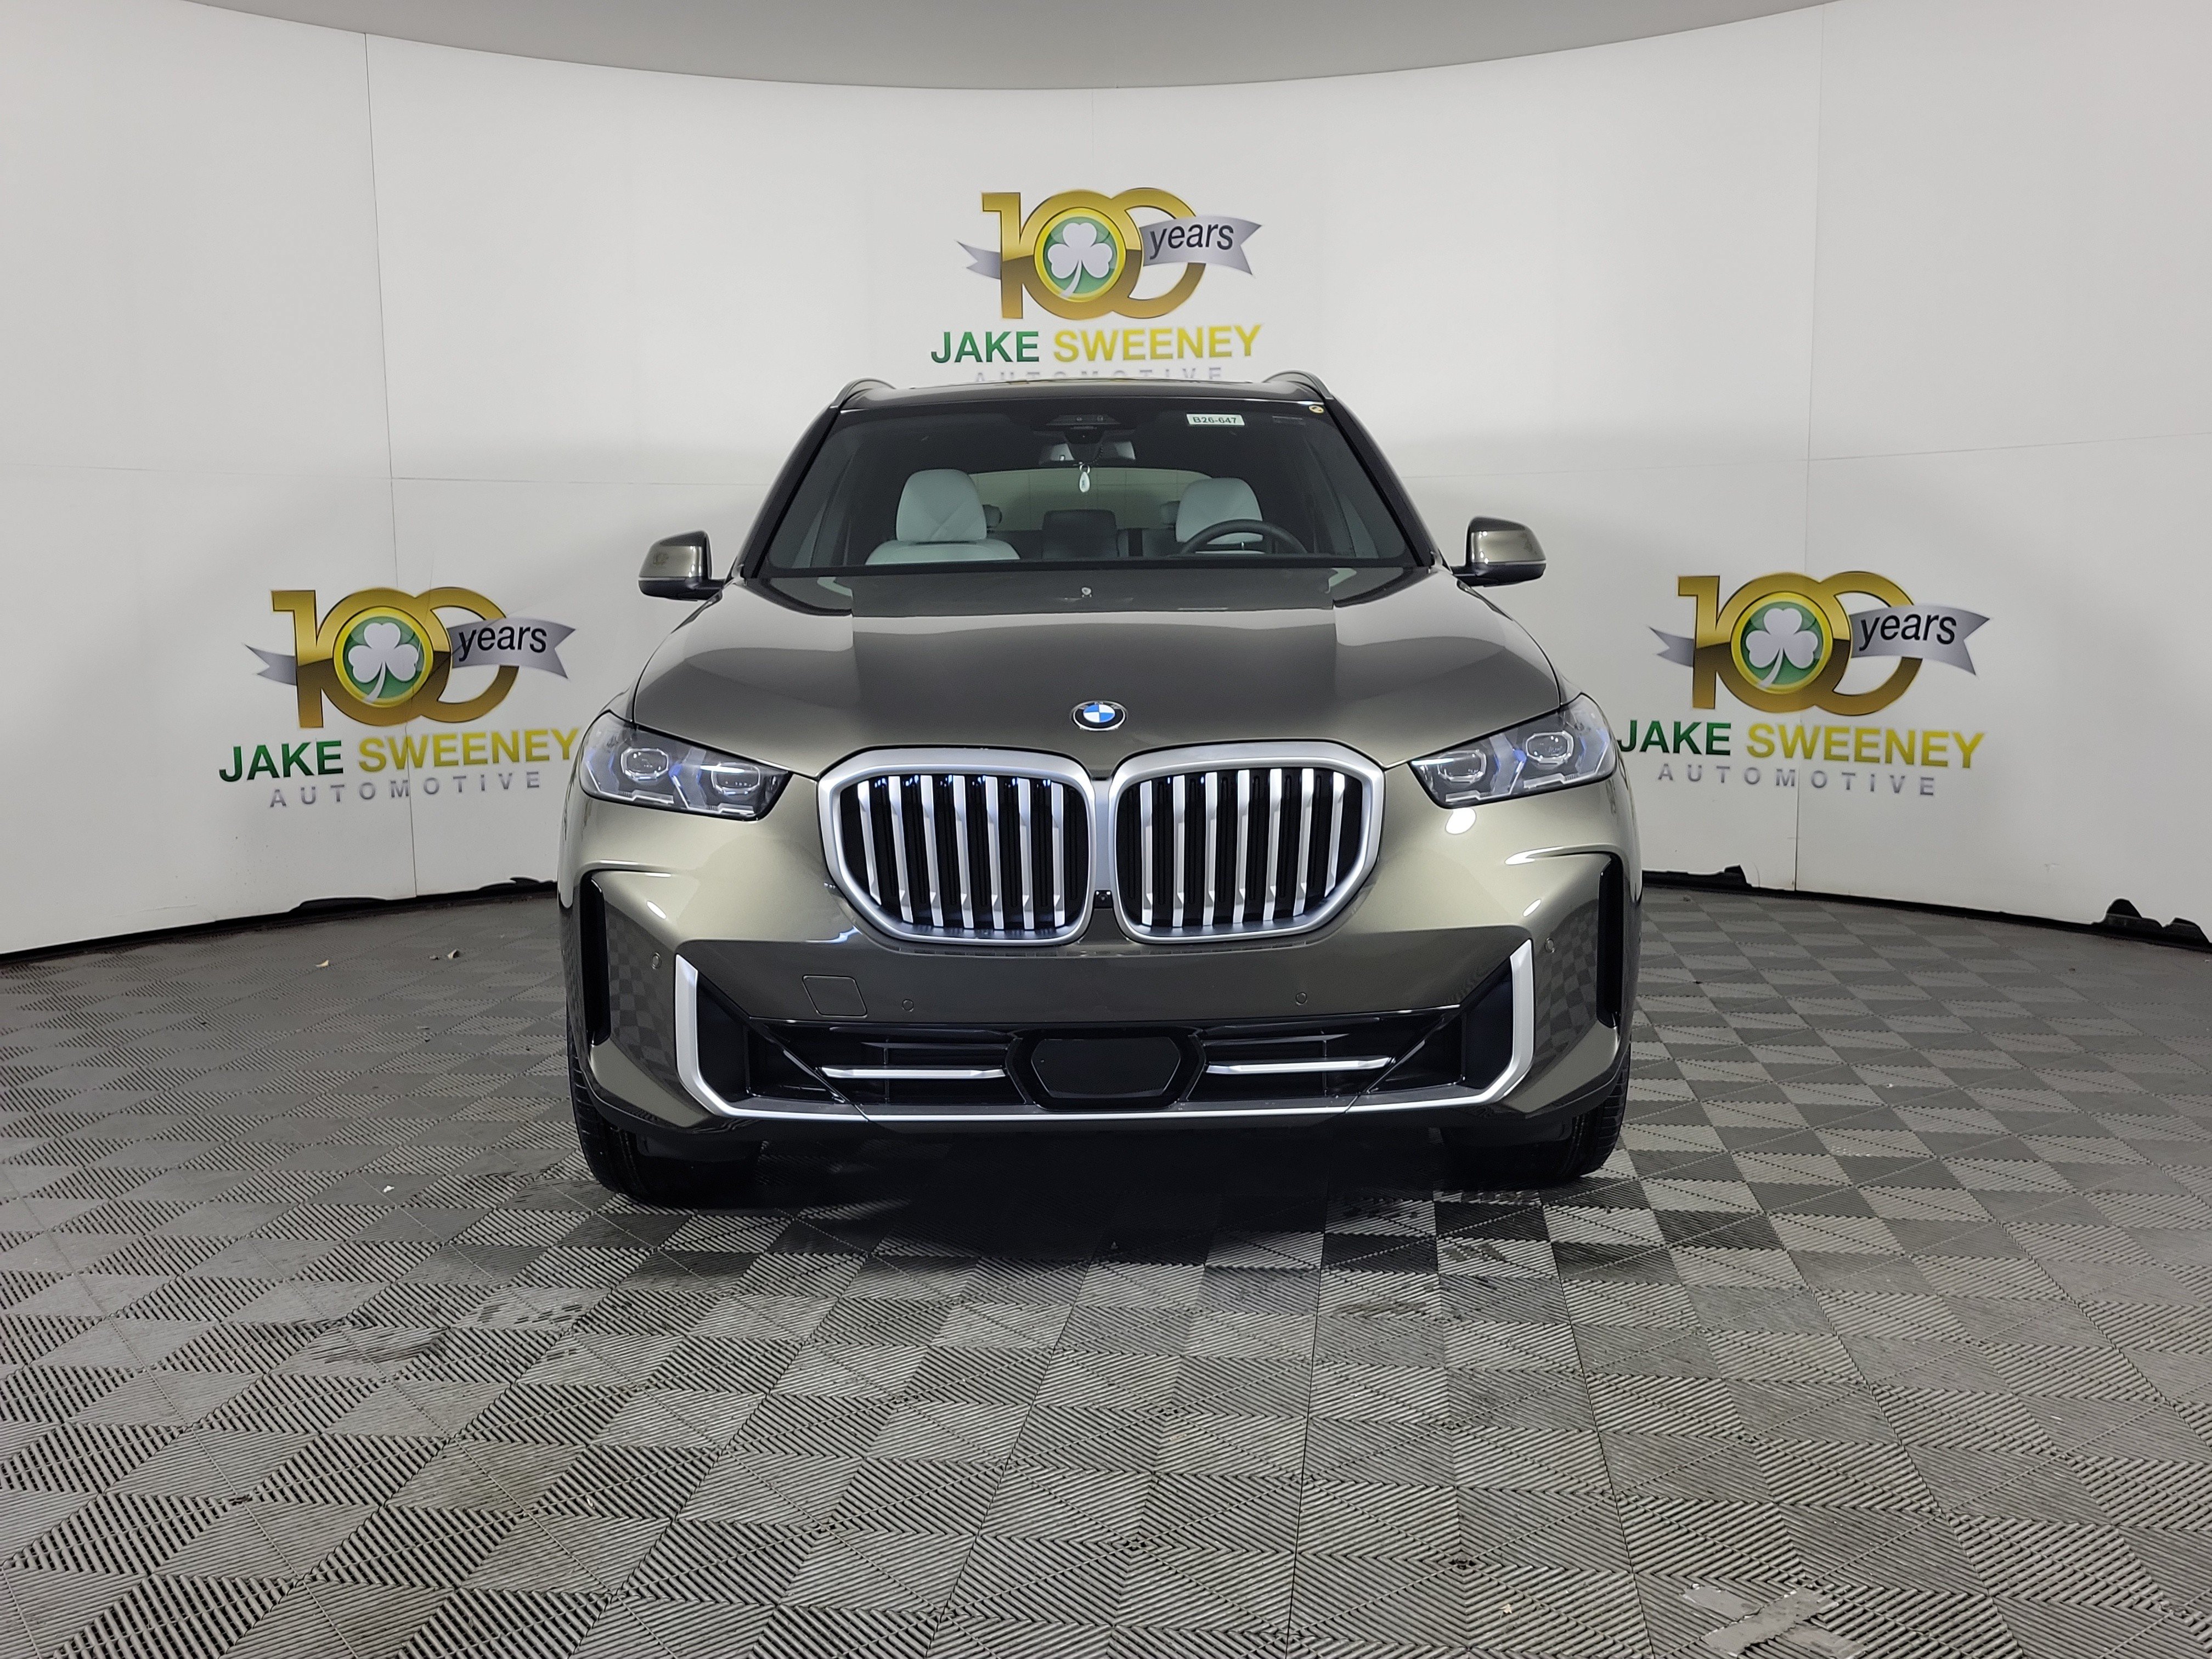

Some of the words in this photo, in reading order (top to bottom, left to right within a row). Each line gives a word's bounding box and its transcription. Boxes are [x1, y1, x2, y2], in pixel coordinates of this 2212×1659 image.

[981, 187, 1205, 320] 100
[1149, 223, 1234, 259] years
[931, 331, 1039, 363] JAKE
[1053, 324, 1261, 362] SWEENEY
[270, 586, 520, 729] 100
[459, 625, 548, 662] years
[1677, 571, 1923, 716] 100
[1859, 614, 1956, 651] years
[219, 740, 345, 782] JAKE
[358, 727, 580, 773] SWEENEY
[1617, 720, 1731, 755] JAKE
[1746, 723, 1985, 769] SWEENEY
[269, 771, 541, 808] AUTOMOTIVE
[1658, 763, 1935, 796] AUTOMOTIVE
